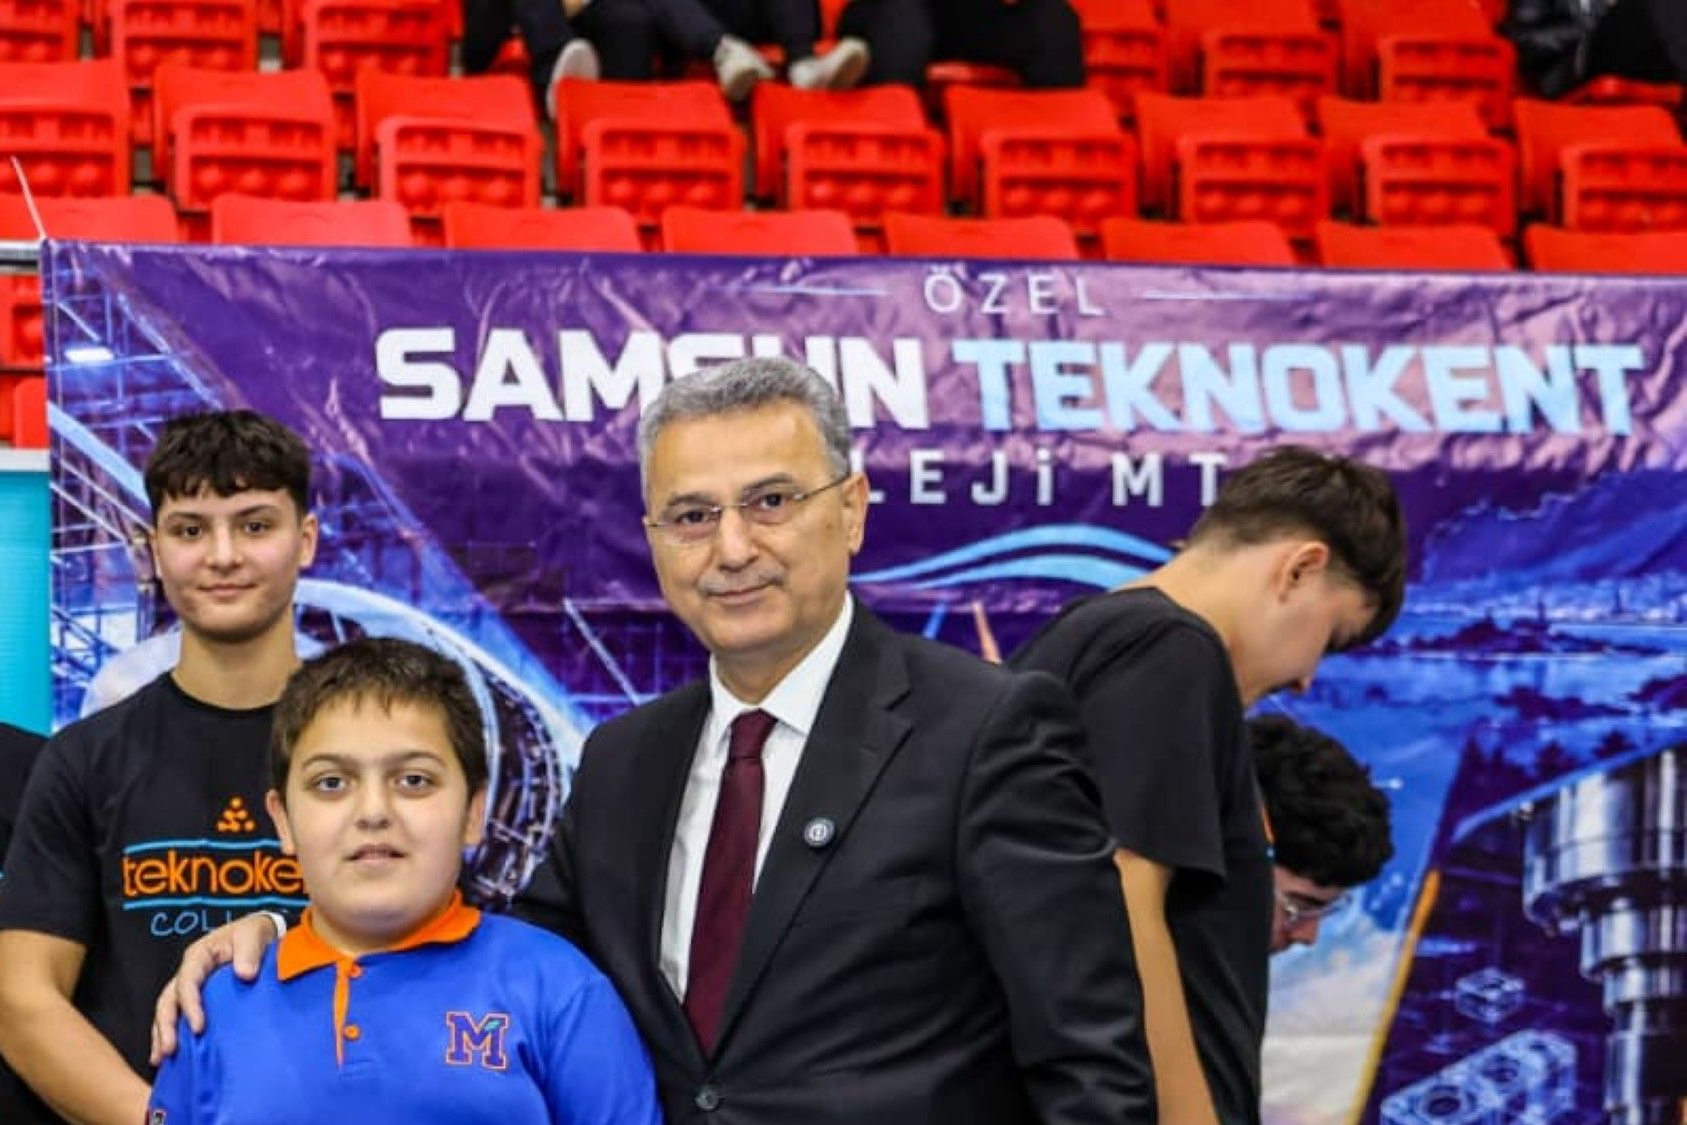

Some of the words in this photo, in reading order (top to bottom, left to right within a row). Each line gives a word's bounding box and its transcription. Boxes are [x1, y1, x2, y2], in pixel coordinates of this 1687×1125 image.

[924, 263, 1106, 316] ÖZEL
[951, 339, 1645, 436] TEKNOKENT
[1111, 452, 1230, 507] MT
[123, 850, 304, 897] teknoke
[445, 1010, 511, 1070] M
